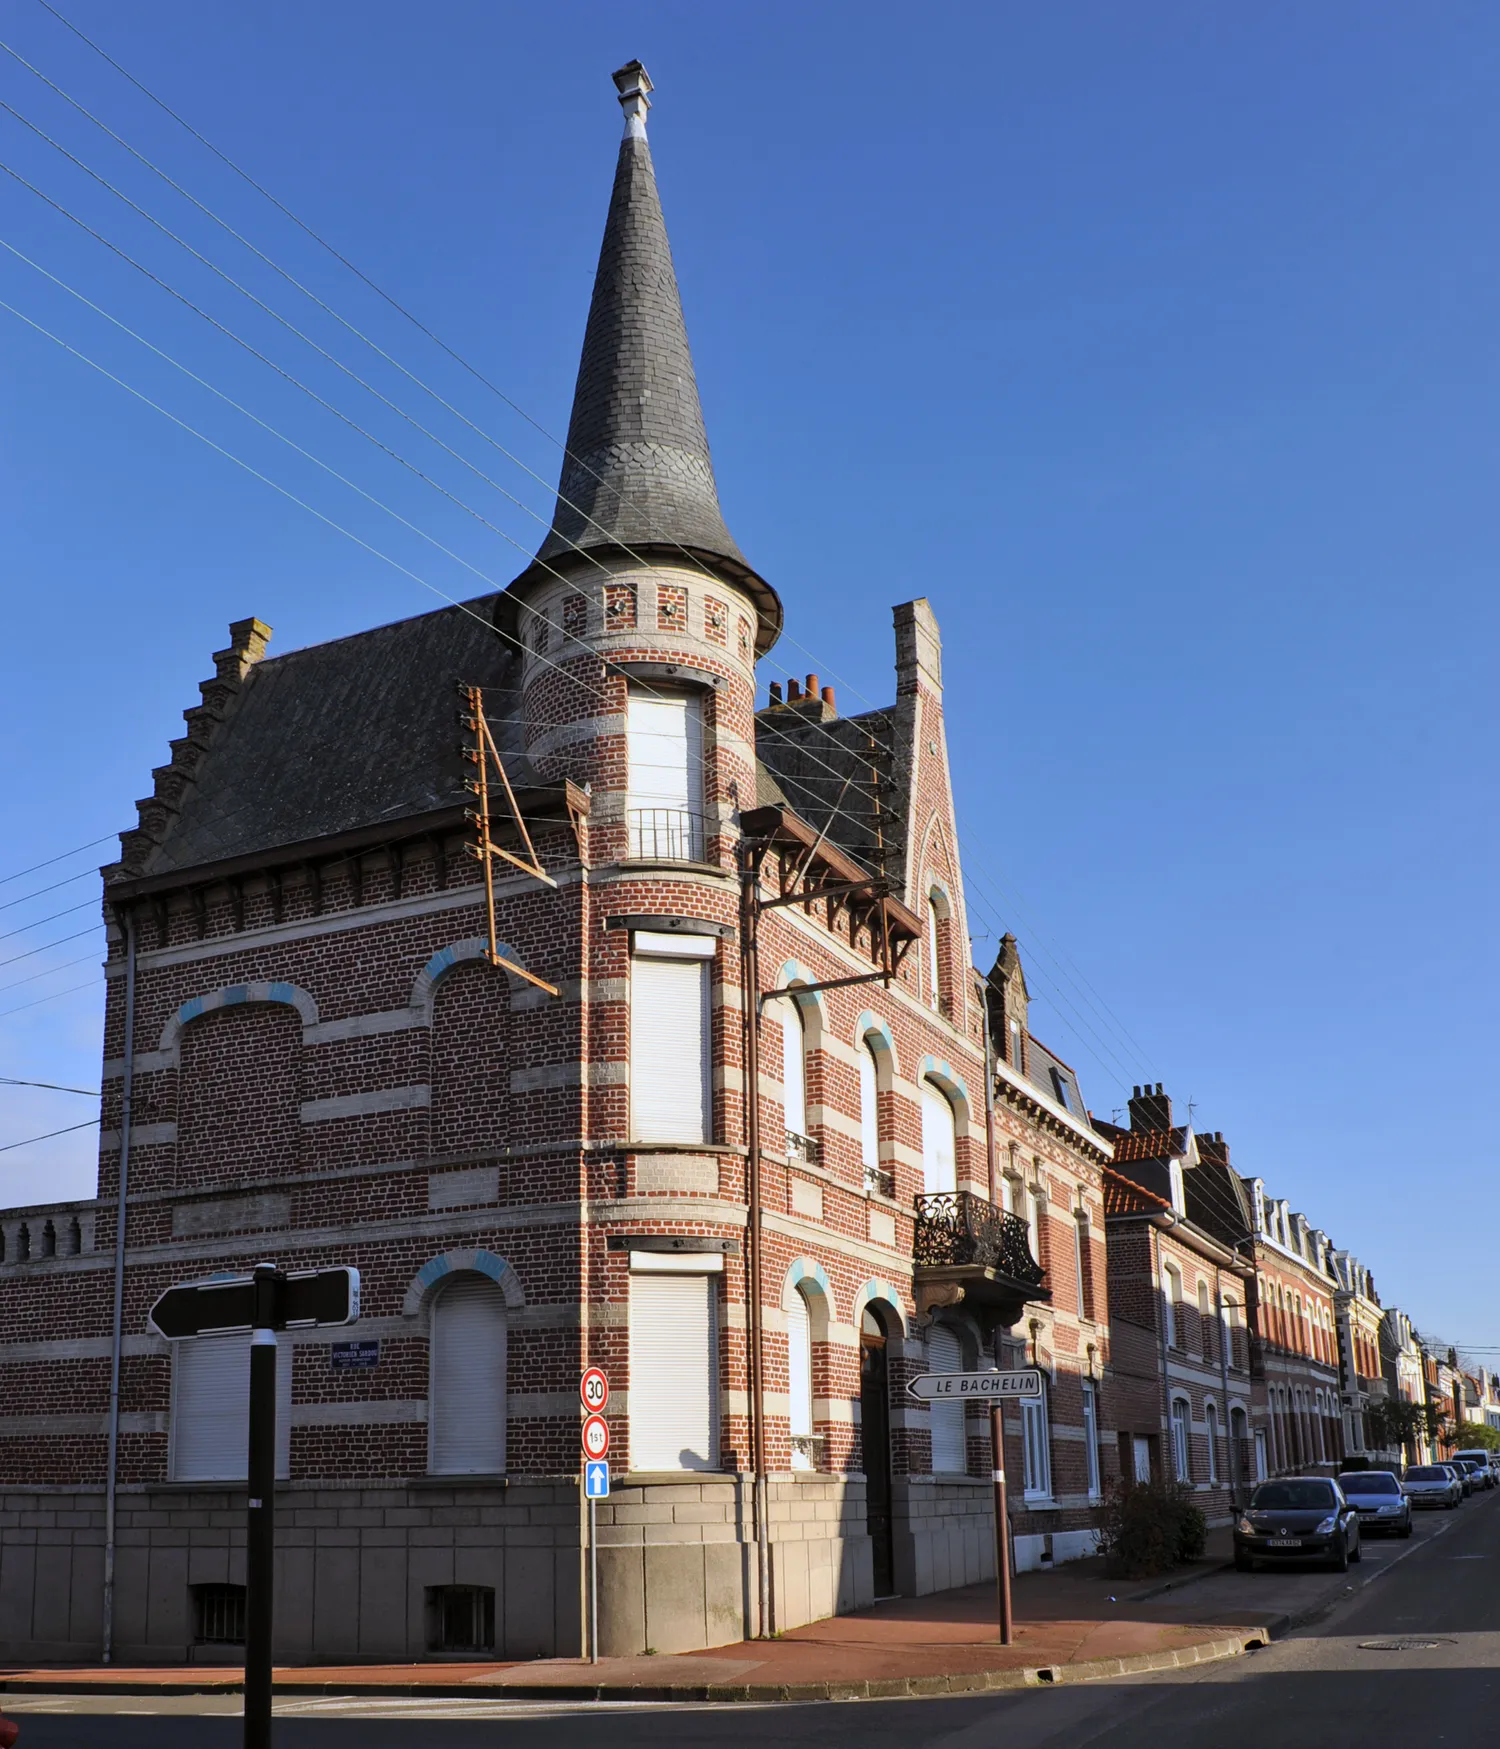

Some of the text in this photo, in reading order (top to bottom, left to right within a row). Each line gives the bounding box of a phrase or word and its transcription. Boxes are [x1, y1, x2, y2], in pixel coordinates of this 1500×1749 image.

[587, 1381, 603, 1399] 30
[936, 1377, 1035, 1393] LE BACHELIN
